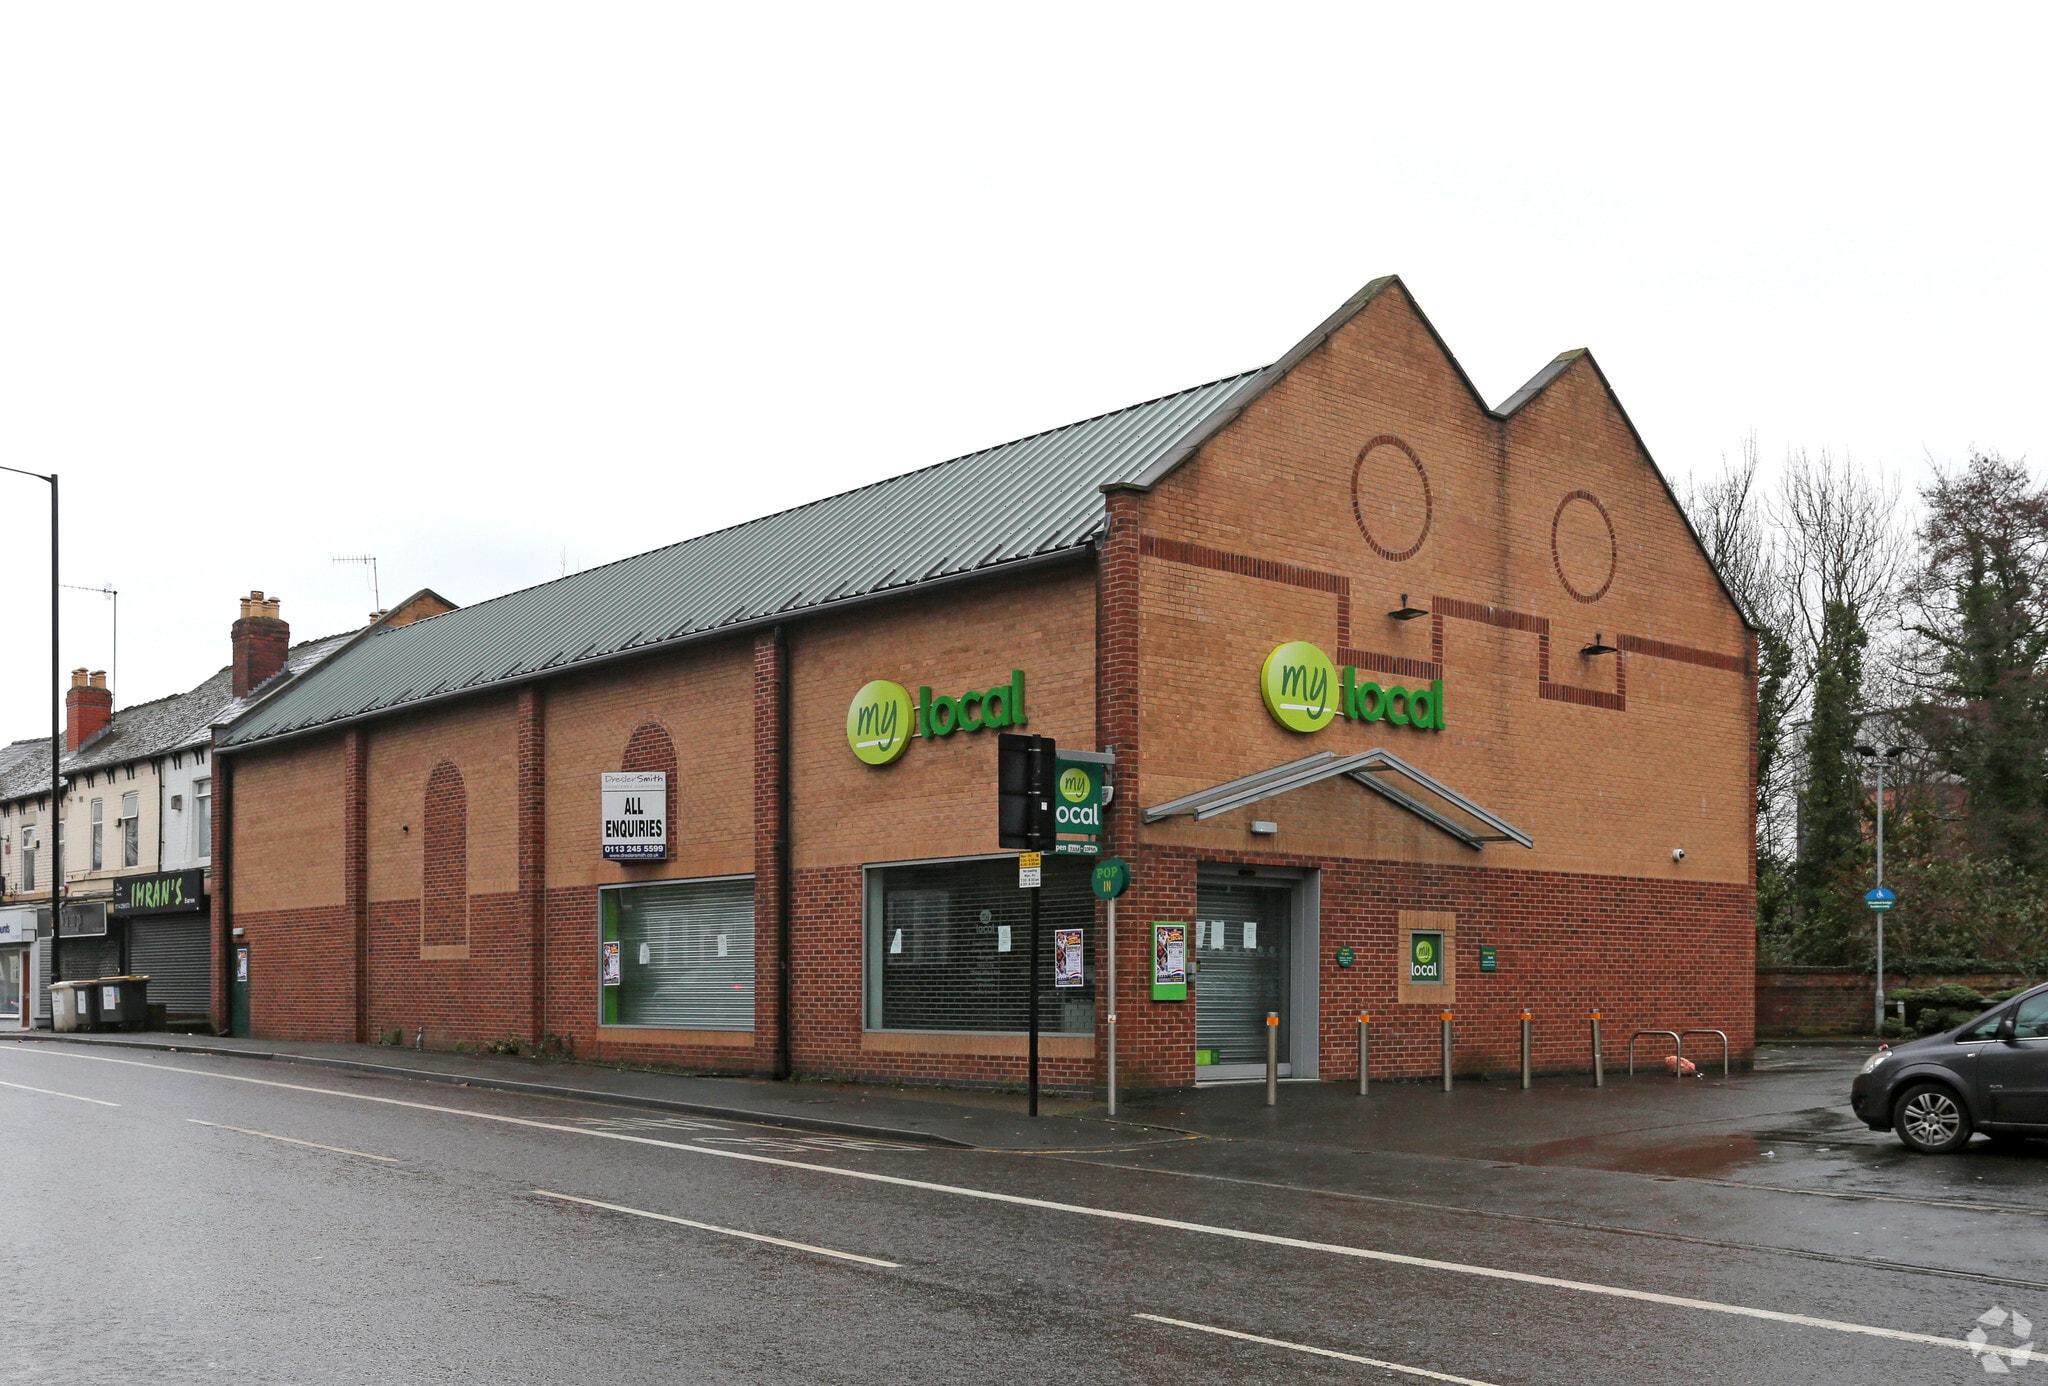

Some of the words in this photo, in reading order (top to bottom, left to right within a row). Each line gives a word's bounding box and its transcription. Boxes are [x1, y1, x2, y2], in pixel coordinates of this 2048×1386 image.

[1281, 664, 1328, 720] my
[1343, 665, 1446, 731] local
[857, 699, 897, 752] my
[919, 669, 1028, 738] local
[1065, 776, 1086, 798] my
[624, 797, 644, 815] ALL
[1055, 803, 1099, 825] ocal
[606, 820, 662, 838] ENQUIRIES
[1097, 866, 1118, 878] POP
[131, 877, 182, 908] IMRAN'S
[1103, 881, 1112, 892] IN
[0, 923, 10, 934] unts
[1418, 946, 1430, 960] my
[1411, 962, 1437, 976] local
